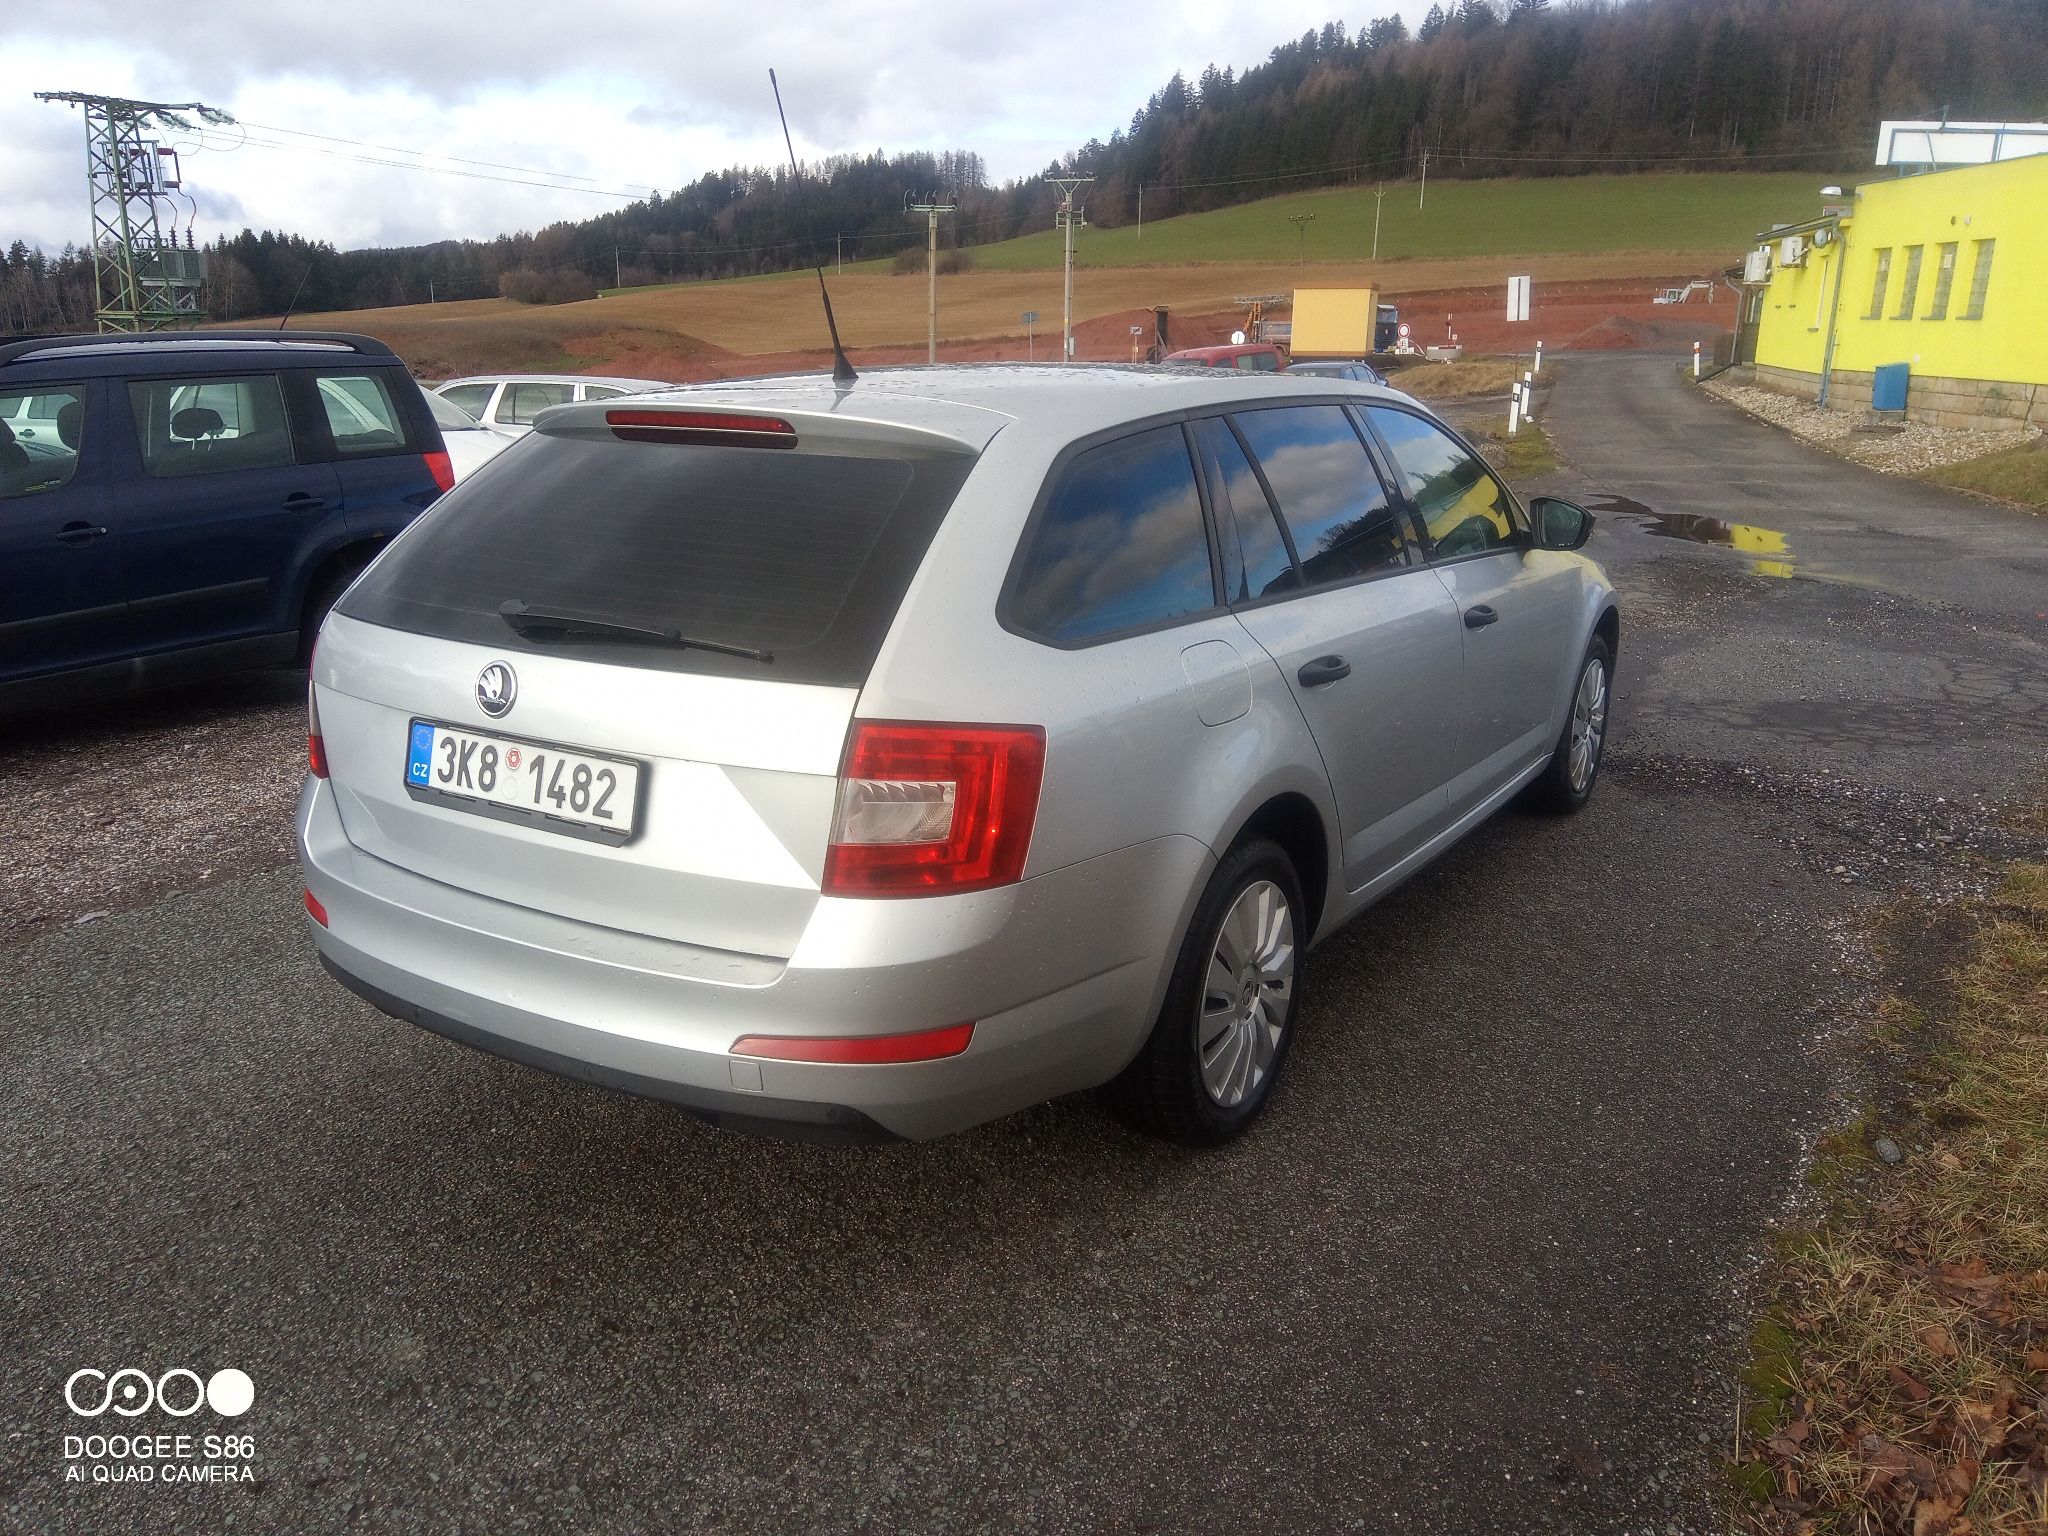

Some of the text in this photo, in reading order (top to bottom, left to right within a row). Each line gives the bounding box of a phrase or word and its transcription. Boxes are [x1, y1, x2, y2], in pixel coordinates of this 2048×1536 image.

[412, 762, 428, 777] CZ
[437, 736, 617, 820] 3K8 1482
